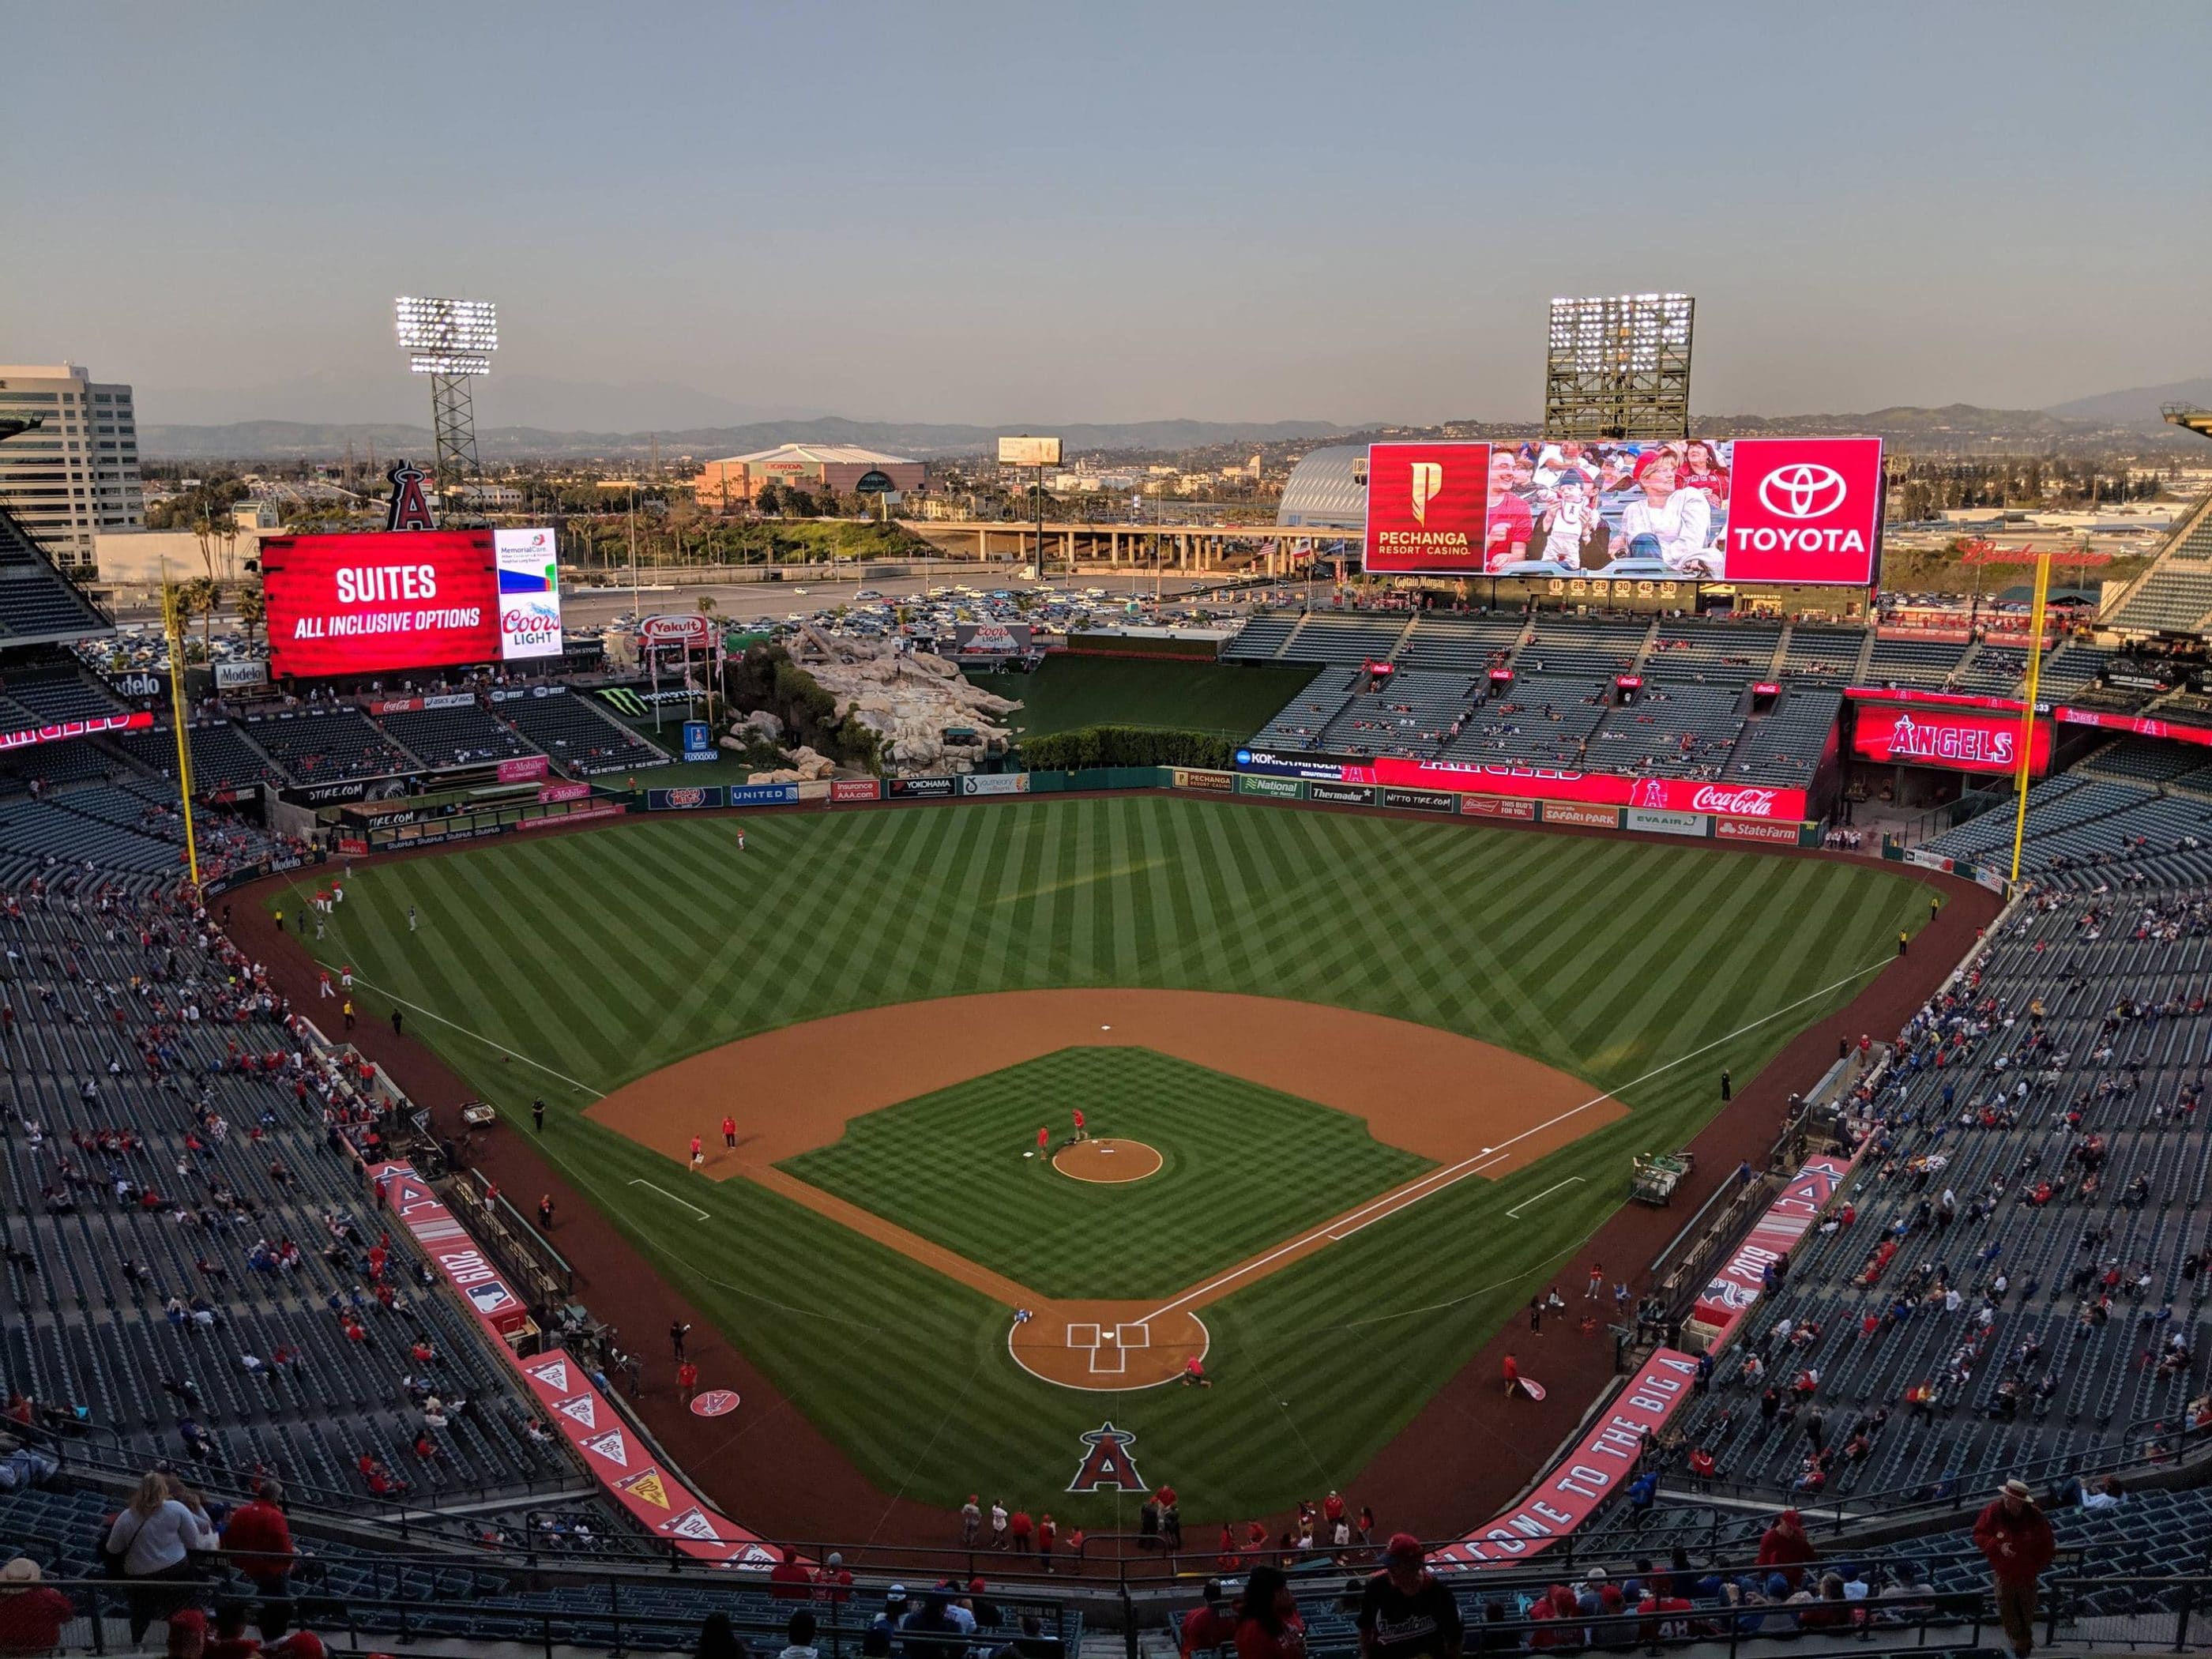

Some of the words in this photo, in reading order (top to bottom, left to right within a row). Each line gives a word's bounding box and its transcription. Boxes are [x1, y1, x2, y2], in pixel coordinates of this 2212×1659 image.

[1379, 532, 1468, 545] PECHANGA
[1734, 528, 1865, 552] TOYOTA
[1379, 546, 1420, 555] RESORT
[1427, 547, 1469, 555] CASINO
[337, 564, 436, 603] SUITES
[1394, 576, 1420, 589] Captain
[1420, 576, 1445, 590] Morgan
[1618, 582, 1628, 591] 30
[1663, 583, 1674, 592] 50
[294, 618, 325, 639] ALL
[329, 611, 412, 637] INCLUSIVE
[415, 608, 480, 630] OPTIONS
[502, 609, 560, 634] Coors
[655, 622, 699, 632] Yakult
[977, 623, 1009, 637] Coors
[514, 632, 551, 645] LIGHT
[223, 667, 261, 681] Modelo
[506, 690, 524, 699] WEST
[2066, 709, 2099, 725] ANGELS
[1888, 714, 2013, 763] ANGELS
[907, 780, 950, 788] YOKOHAMA
[979, 777, 1014, 788] youtheory
[1191, 774, 1231, 784] PECHANGA
[1256, 780, 1297, 792] National
[734, 790, 783, 799] UNITED
[1313, 788, 1363, 801] Thermador
[1386, 793, 1411, 803] NITTO
[1413, 796, 1451, 807] TIRE.COM
[1692, 786, 1778, 816] Coca-Cola
[1546, 810, 1584, 822] SAFARI
[1586, 813, 1615, 824] PARK
[1637, 815, 1660, 824] EVA
[1661, 817, 1682, 826] AIR
[387, 839, 415, 850] StubHub
[417, 836, 444, 845] StubHub
[446, 830, 472, 841] StubHub
[475, 827, 500, 836] StubHub
[272, 856, 301, 871] Modelo
[439, 1250, 495, 1284] 2019
[1728, 1245, 1778, 1283] 2019
[1557, 1465, 1609, 1499] TO
[1591, 1416, 1650, 1459] THE
[1628, 1375, 1681, 1413] BIG
[1658, 1357, 1696, 1375] A
